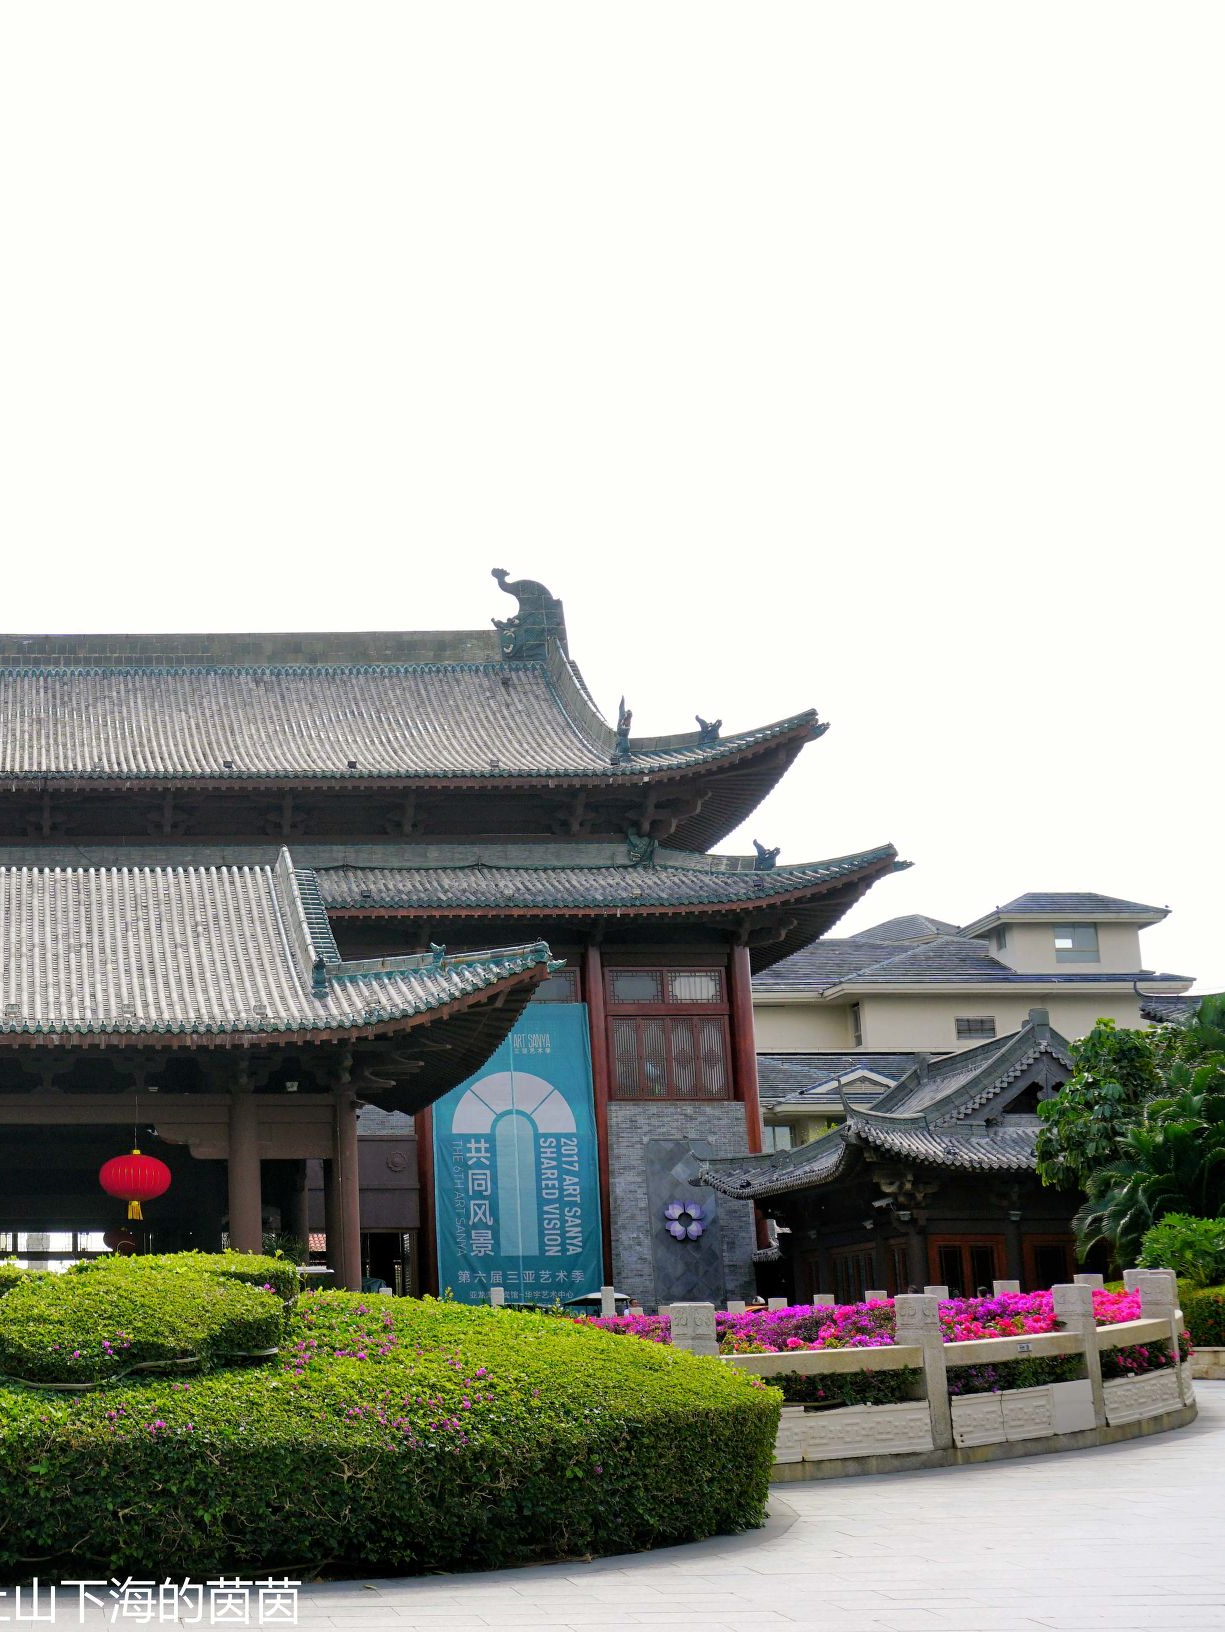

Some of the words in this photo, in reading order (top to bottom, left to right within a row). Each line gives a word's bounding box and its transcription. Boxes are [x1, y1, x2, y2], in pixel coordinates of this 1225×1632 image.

[513, 1033, 526, 1048] ART
[527, 1033, 551, 1048] SANYA
[452, 1139, 463, 1162] THE
[560, 1138, 579, 1171] 2017
[453, 1165, 465, 1188] 6TH
[539, 1138, 559, 1199] SHARED
[454, 1191, 466, 1214] ART
[466, 1138, 495, 1257] 共同风景
[563, 1175, 581, 1203] ART
[456, 1217, 467, 1256] SANYA
[543, 1204, 562, 1256] VISION
[564, 1207, 583, 1256] SANYA
[457, 1270, 585, 1284] 第六届三亚艺术季
